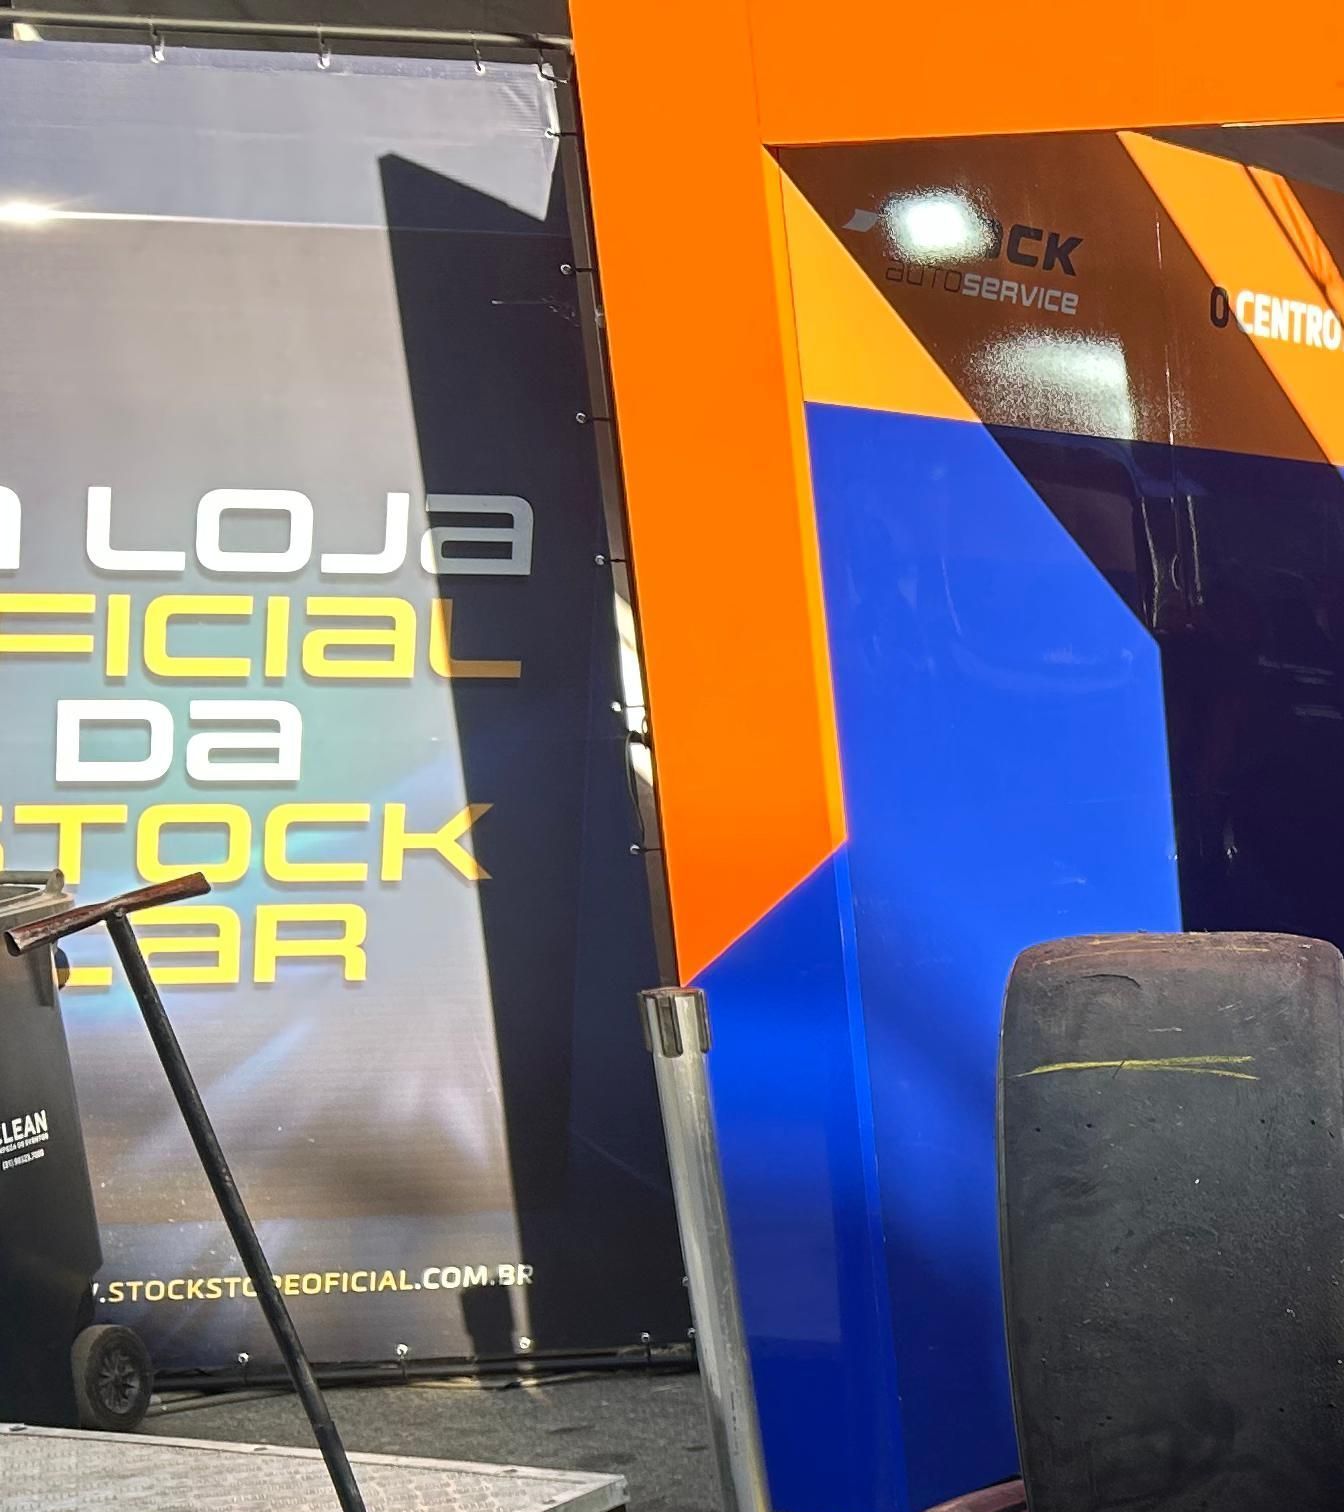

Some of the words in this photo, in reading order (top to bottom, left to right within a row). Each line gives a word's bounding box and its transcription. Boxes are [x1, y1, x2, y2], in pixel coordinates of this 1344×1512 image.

[1210, 286, 1229, 328] O
[1235, 290, 1341, 351] CENTRO
[0, 803, 494, 884] TOCK
[0, 1109, 48, 1145] LEAN
